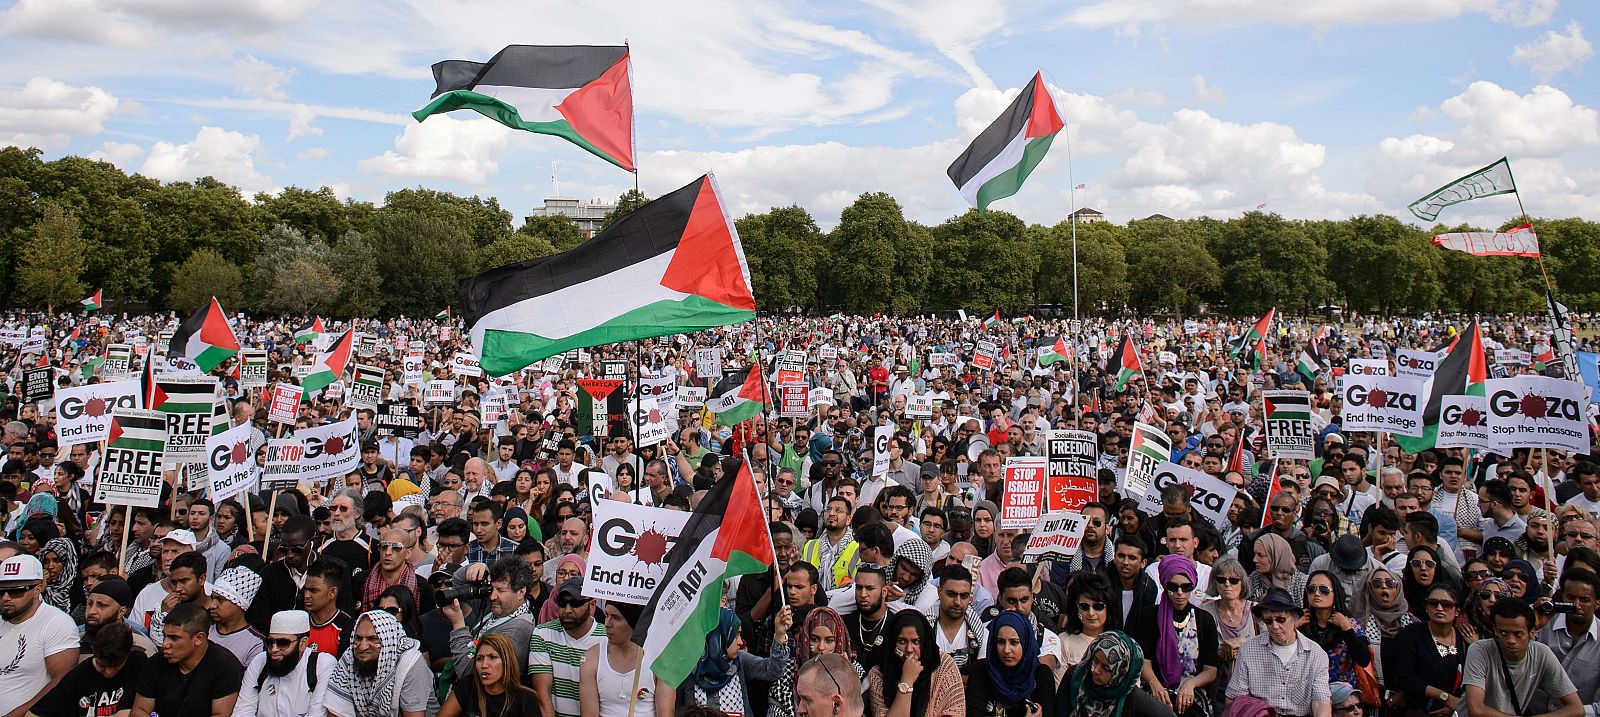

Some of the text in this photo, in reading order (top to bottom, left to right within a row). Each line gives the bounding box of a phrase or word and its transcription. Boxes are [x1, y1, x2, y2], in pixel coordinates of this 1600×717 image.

[105, 359, 128, 370] FREE
[169, 356, 196, 370] Gza
[455, 356, 480, 368] Gza
[605, 363, 625, 375] END
[1398, 354, 1434, 371] Gza
[29, 371, 48, 381] END
[241, 365, 265, 375] FREE
[1351, 364, 1386, 376] Gza
[280, 389, 297, 398] STOP
[351, 382, 381, 399] FREE
[640, 381, 674, 396] Gza
[276, 395, 298, 405] ISRAELI
[678, 394, 704, 402] PALESTINE
[1346, 384, 1417, 411] Gza
[60, 394, 137, 419] Gza
[276, 402, 294, 412] STATE
[389, 404, 408, 416] FREE
[1490, 389, 1582, 422] Gza
[272, 408, 295, 418] TERROR
[1443, 404, 1488, 427] Gz
[167, 414, 212, 435] REE
[378, 414, 419, 427] PALESTINE
[1346, 413, 1417, 430] End the siege
[61, 422, 104, 437] End the
[586, 424, 613, 435] 24/7
[640, 432, 650, 440] nd
[1267, 420, 1312, 438] FREE
[1440, 430, 1489, 440] Stop the mass
[1492, 424, 1583, 439] Stop the massacre
[167, 435, 209, 446] ESTINE
[304, 429, 357, 459] Gza
[1077, 433, 1094, 441] Worker
[1269, 436, 1313, 447] PALESTINE
[210, 439, 254, 472] Gz
[1051, 440, 1095, 457] FREEDOM
[103, 448, 164, 476] FREE
[302, 460, 336, 474] Stop the
[1131, 450, 1160, 476] FRE
[1014, 469, 1037, 481] STOP
[1050, 462, 1097, 479] PALESTINE
[1129, 467, 1151, 483] PALES
[100, 472, 161, 488] PALESTINE
[213, 475, 233, 492] End
[234, 470, 249, 484] the
[1007, 480, 1040, 493] ISRAELI
[1054, 480, 1095, 494] لفلسطين
[1009, 493, 1035, 505] STATE
[1154, 472, 1226, 514] Gza
[1146, 494, 1164, 507] Stop
[1005, 505, 1038, 519] TERROR
[1043, 520, 1057, 533] END
[1057, 518, 1079, 532] THE
[598, 518, 690, 564] Gz
[590, 565, 656, 591] End the
[594, 588, 606, 596] Stop
[616, 590, 626, 598] War
[626, 592, 650, 601] Coalition
